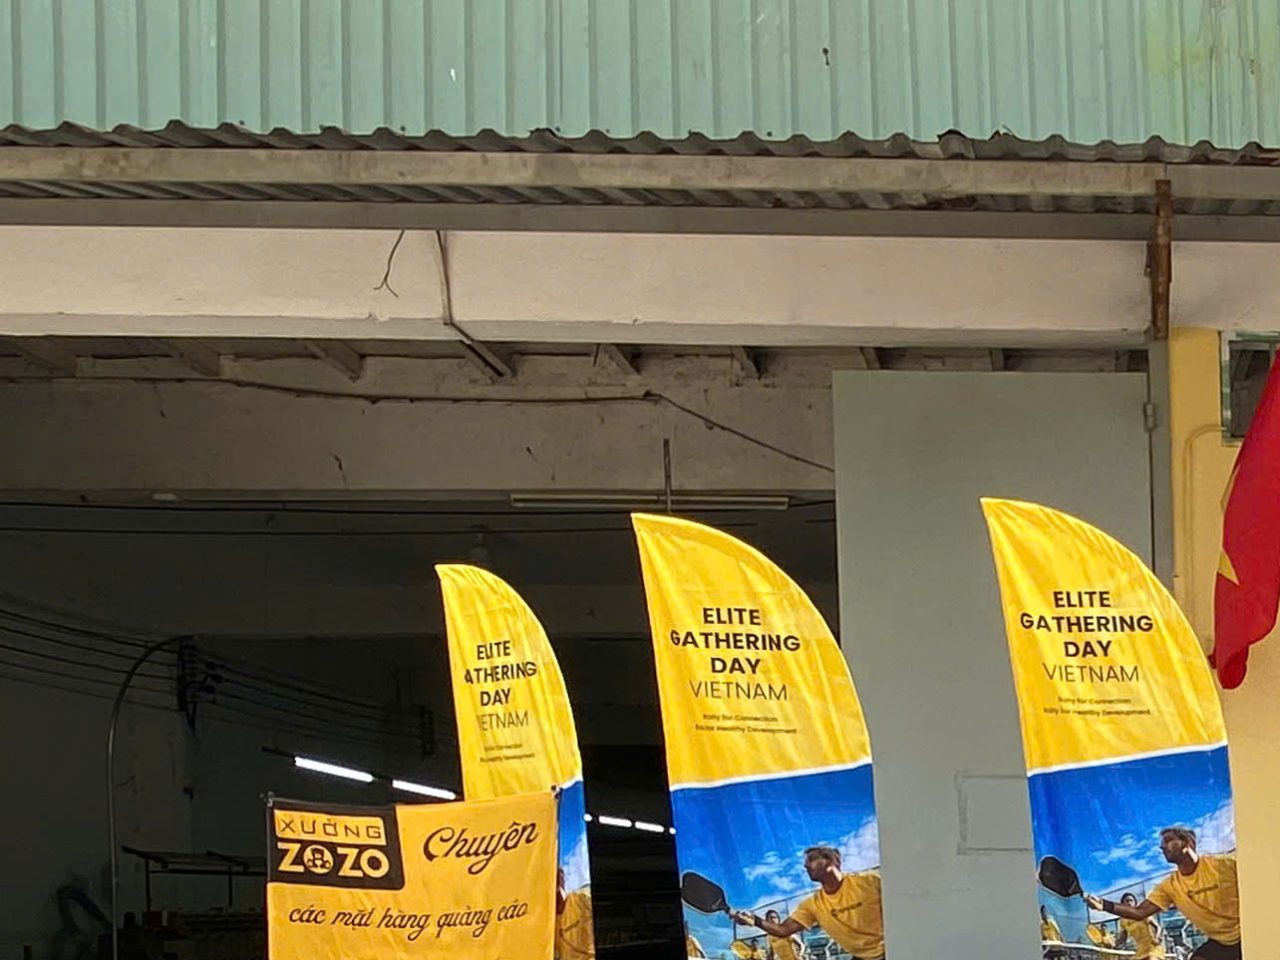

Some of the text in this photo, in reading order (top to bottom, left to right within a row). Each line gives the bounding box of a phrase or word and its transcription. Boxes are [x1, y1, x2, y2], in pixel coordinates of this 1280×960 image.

[1053, 591, 1111, 608] ELITE
[702, 608, 761, 625] ELITE
[1021, 612, 1153, 632] GATHERING
[477, 640, 510, 660] ELITE
[671, 630, 800, 652] GATHERING
[1064, 640, 1112, 658] DAY
[464, 662, 537, 684] ATHERING
[711, 657, 761, 674] DAY
[1042, 662, 1139, 682] VIETNAM
[480, 688, 510, 706] DAY
[689, 680, 787, 700] VIETNAM
[423, 821, 540, 875] Chuyên
[278, 842, 390, 878] ZOZO
[290, 906, 326, 925] các
[377, 908, 430, 942] hàng
[437, 904, 492, 938] quảng
[498, 900, 529, 922] cáo
